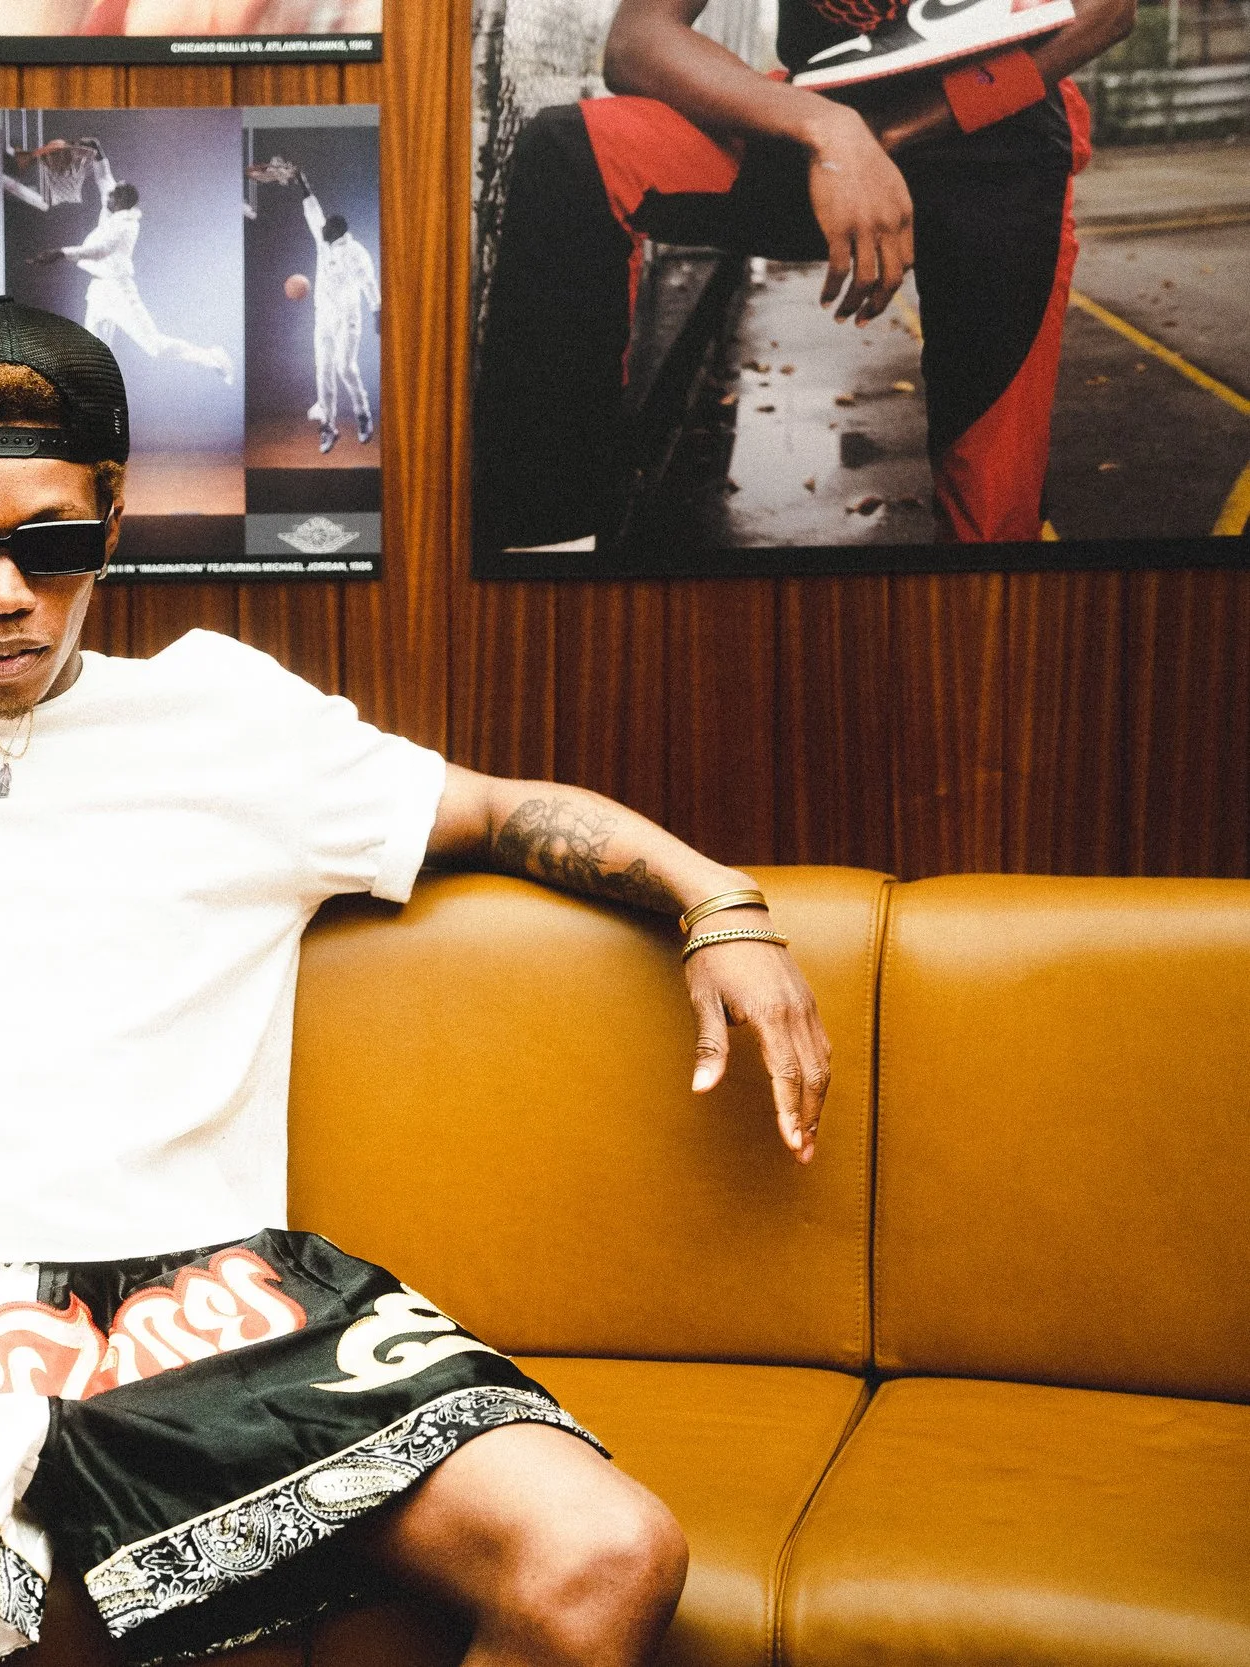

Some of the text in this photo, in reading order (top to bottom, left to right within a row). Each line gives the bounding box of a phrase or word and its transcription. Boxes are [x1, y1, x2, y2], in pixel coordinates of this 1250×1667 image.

[170, 41, 215, 52] CHICAGO
[216, 41, 248, 52] BULLS
[264, 40, 309, 51] ATLANTA
[207, 561, 261, 573] FEATURING
[262, 561, 305, 573] MICHAEL
